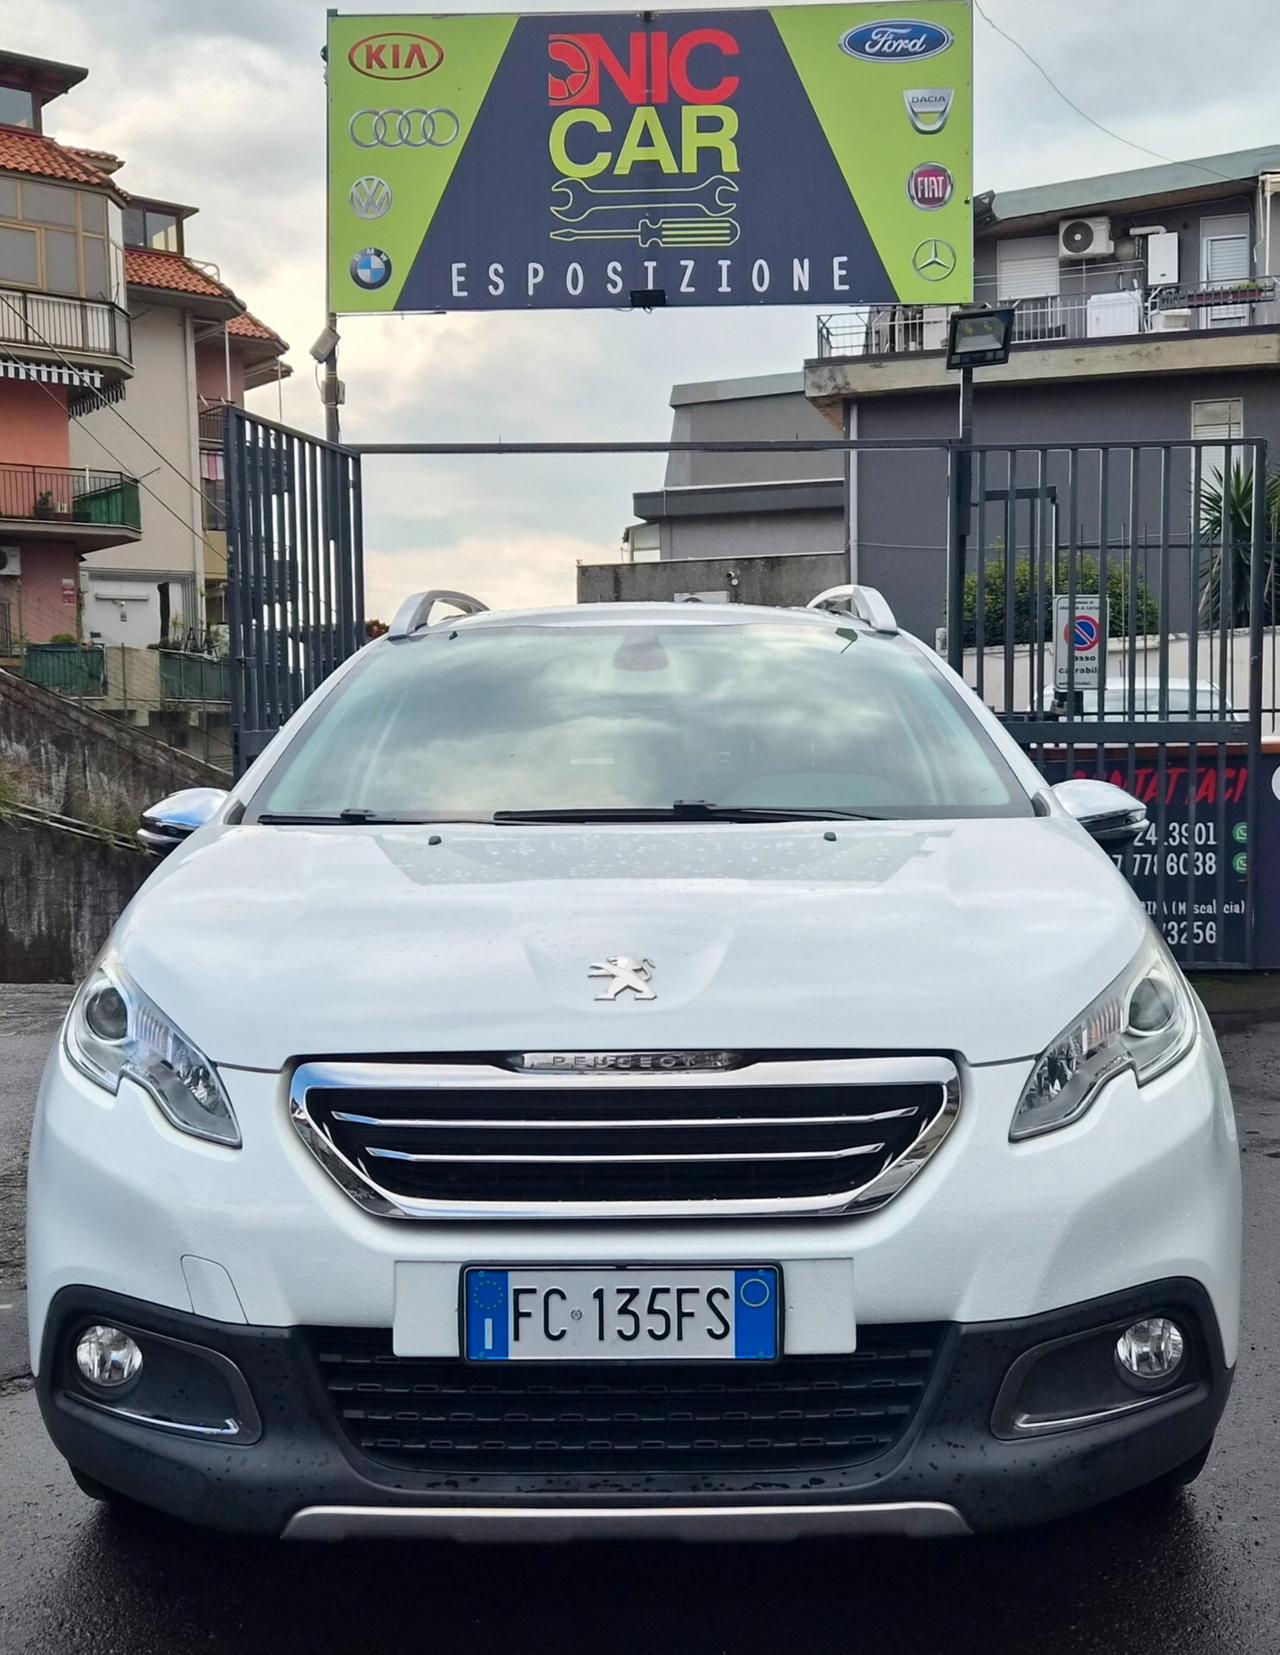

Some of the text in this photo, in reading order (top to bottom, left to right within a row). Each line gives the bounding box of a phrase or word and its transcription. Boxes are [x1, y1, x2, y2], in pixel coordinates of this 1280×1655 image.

[864, 27, 927, 54] Ford
[365, 43, 428, 69] KIA
[911, 96, 946, 104] DACIA
[548, 104, 741, 178] CAR
[917, 176, 944, 198] FIAT
[451, 256, 850, 297] ESPOSIZIONE
[512, 1287, 567, 1341] FC
[592, 1287, 731, 1342] 135FS
